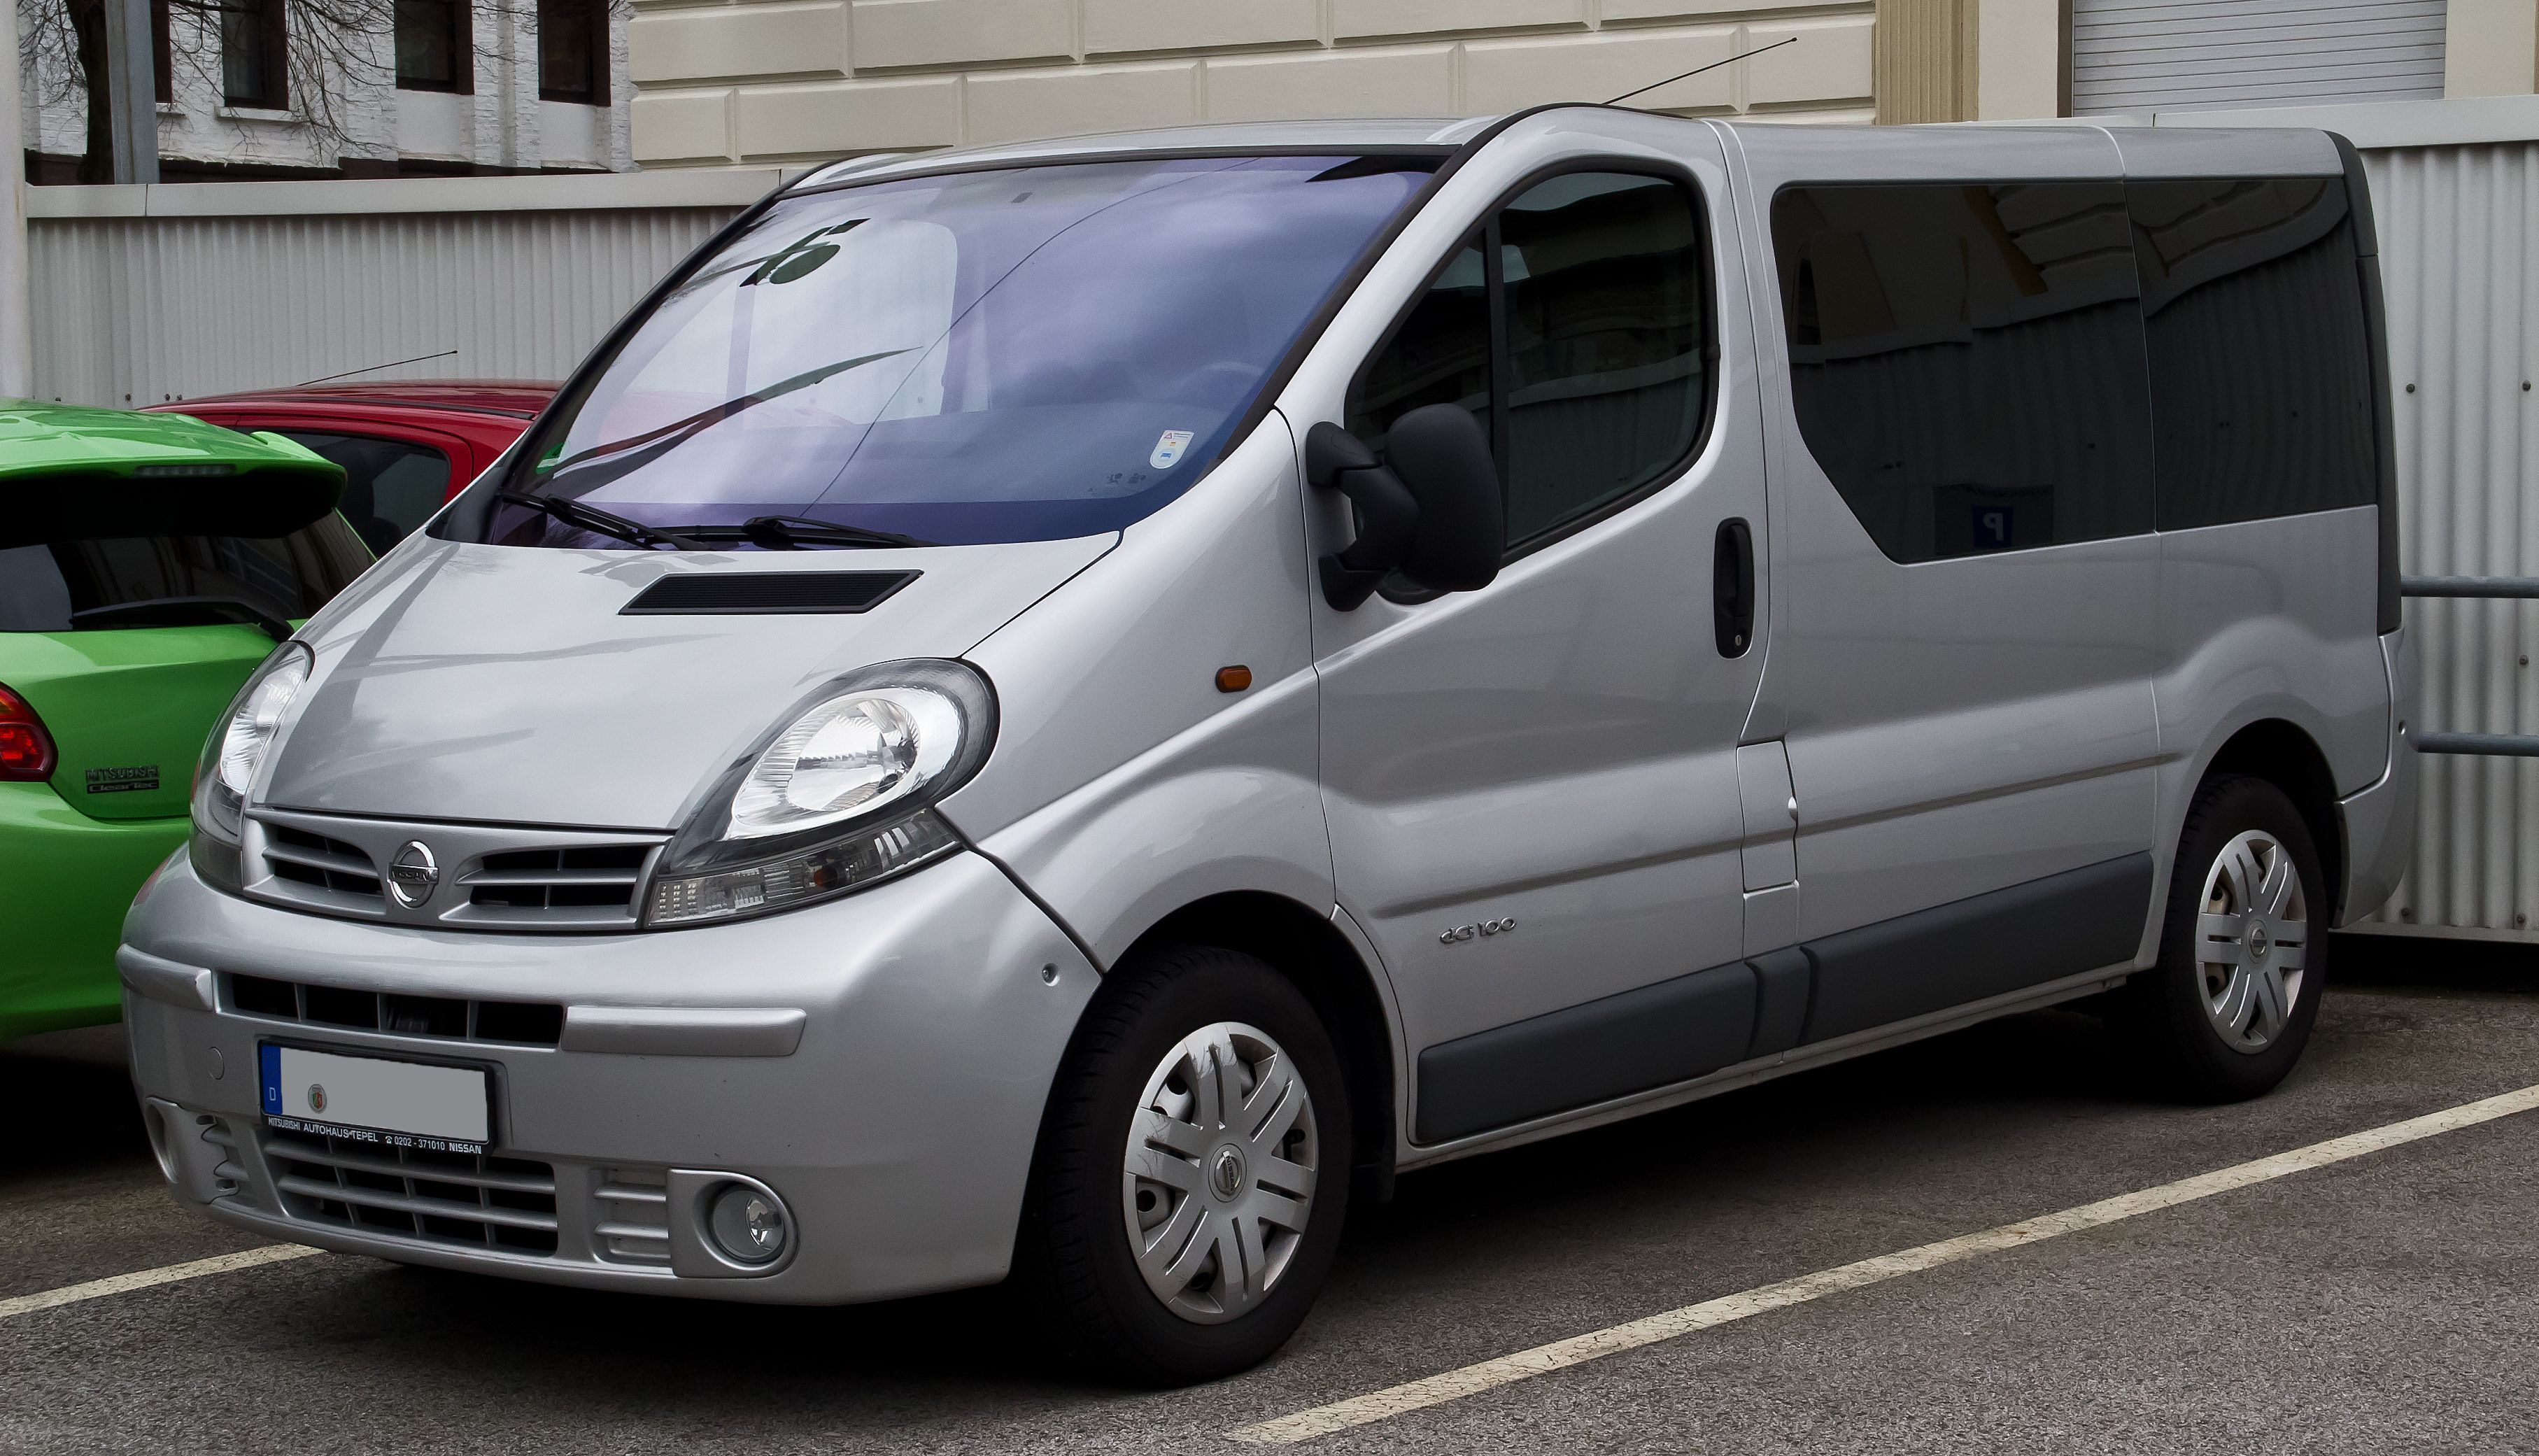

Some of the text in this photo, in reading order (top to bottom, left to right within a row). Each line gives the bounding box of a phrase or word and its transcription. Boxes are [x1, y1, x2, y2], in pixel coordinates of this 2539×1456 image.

[86, 765, 159, 783] MITSUBISHI
[89, 782, 157, 792] ClearTec
[391, 870, 432, 882] NSSAN
[269, 1087, 276, 1101] D
[269, 1117, 300, 1131] MITSUBISHI
[304, 1123, 350, 1138] AUTOHAUS
[351, 1130, 379, 1143] TEPEL
[394, 1136, 412, 1147] 0202
[418, 1138, 445, 1151] 371010
[449, 1143, 482, 1154] NISSAN
